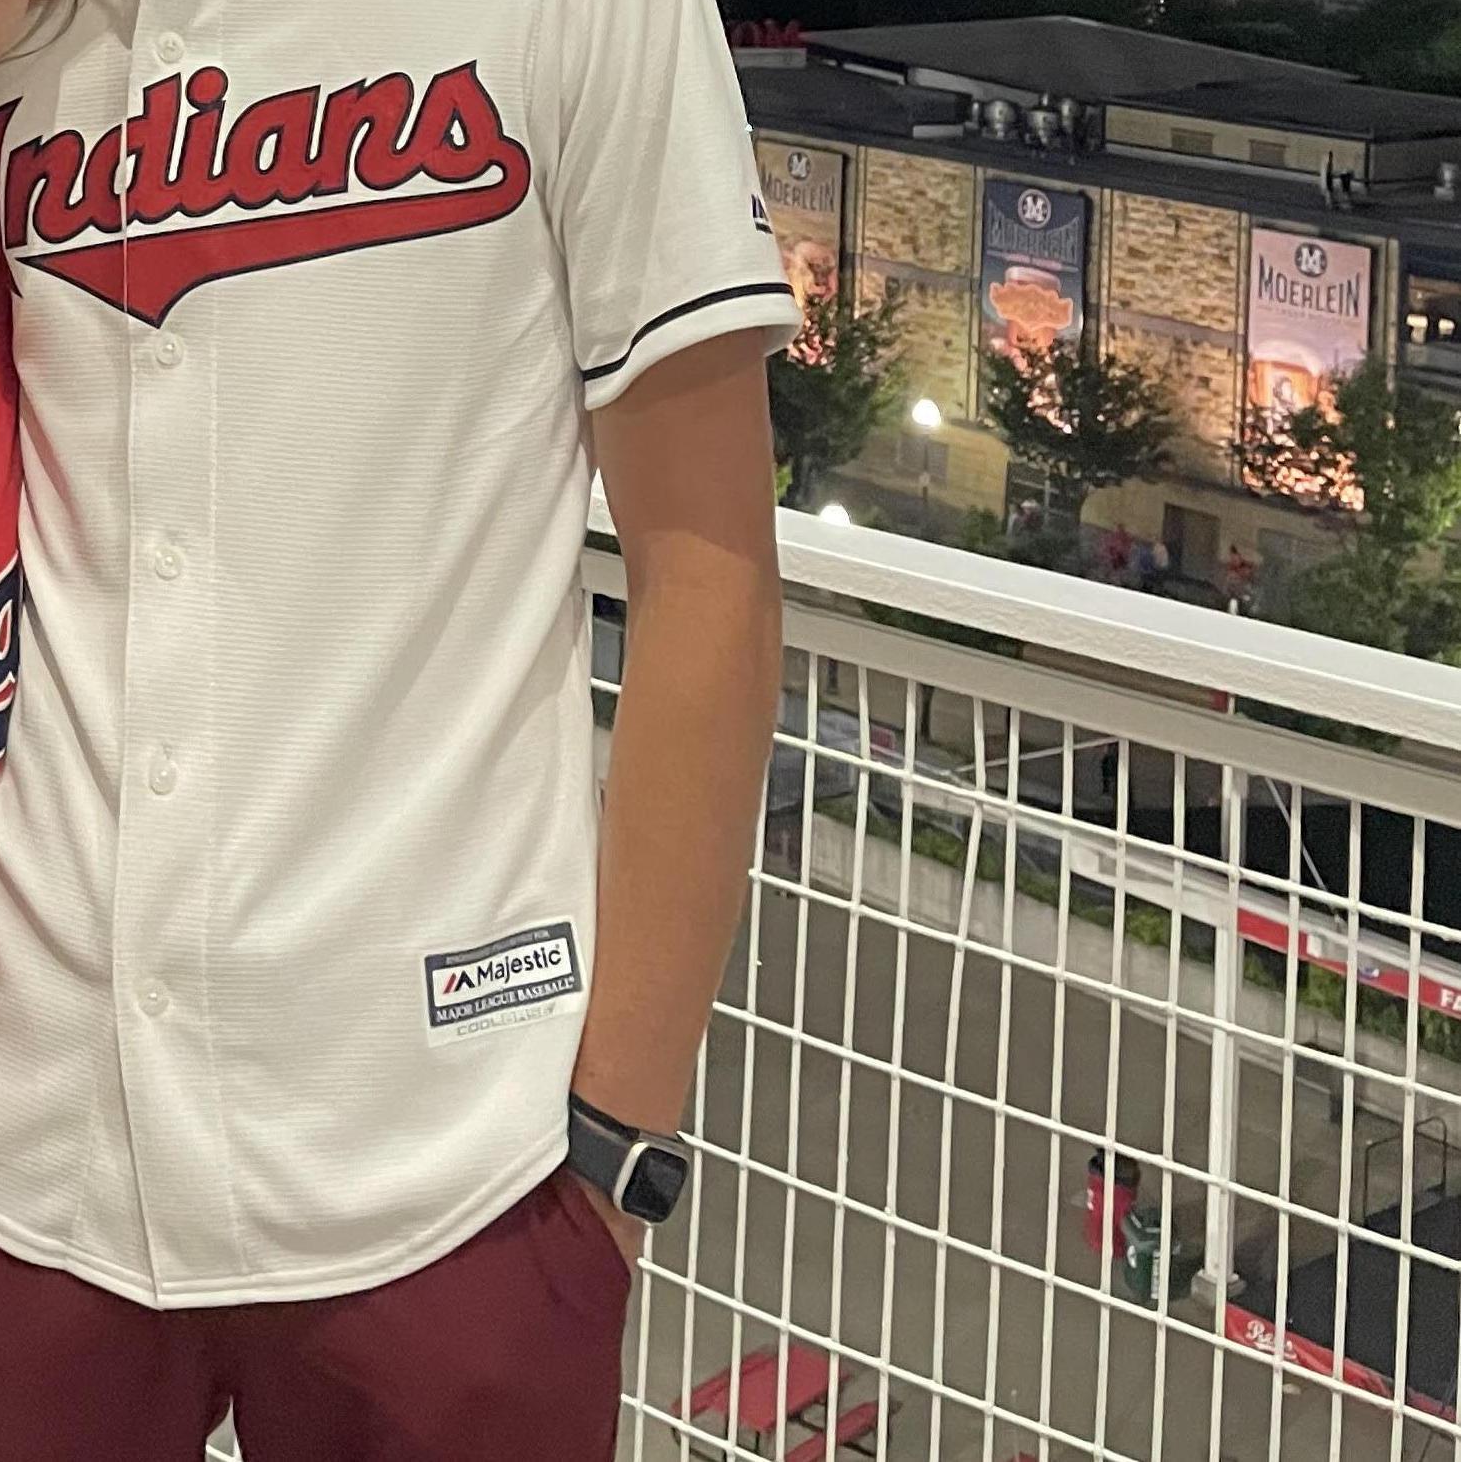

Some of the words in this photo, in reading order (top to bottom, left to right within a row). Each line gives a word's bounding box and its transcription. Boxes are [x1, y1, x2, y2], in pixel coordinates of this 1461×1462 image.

[1258, 255, 1361, 318] MOERLEIN
[477, 945, 562, 986] Majestic
[436, 1000, 474, 1022] MAJOR
